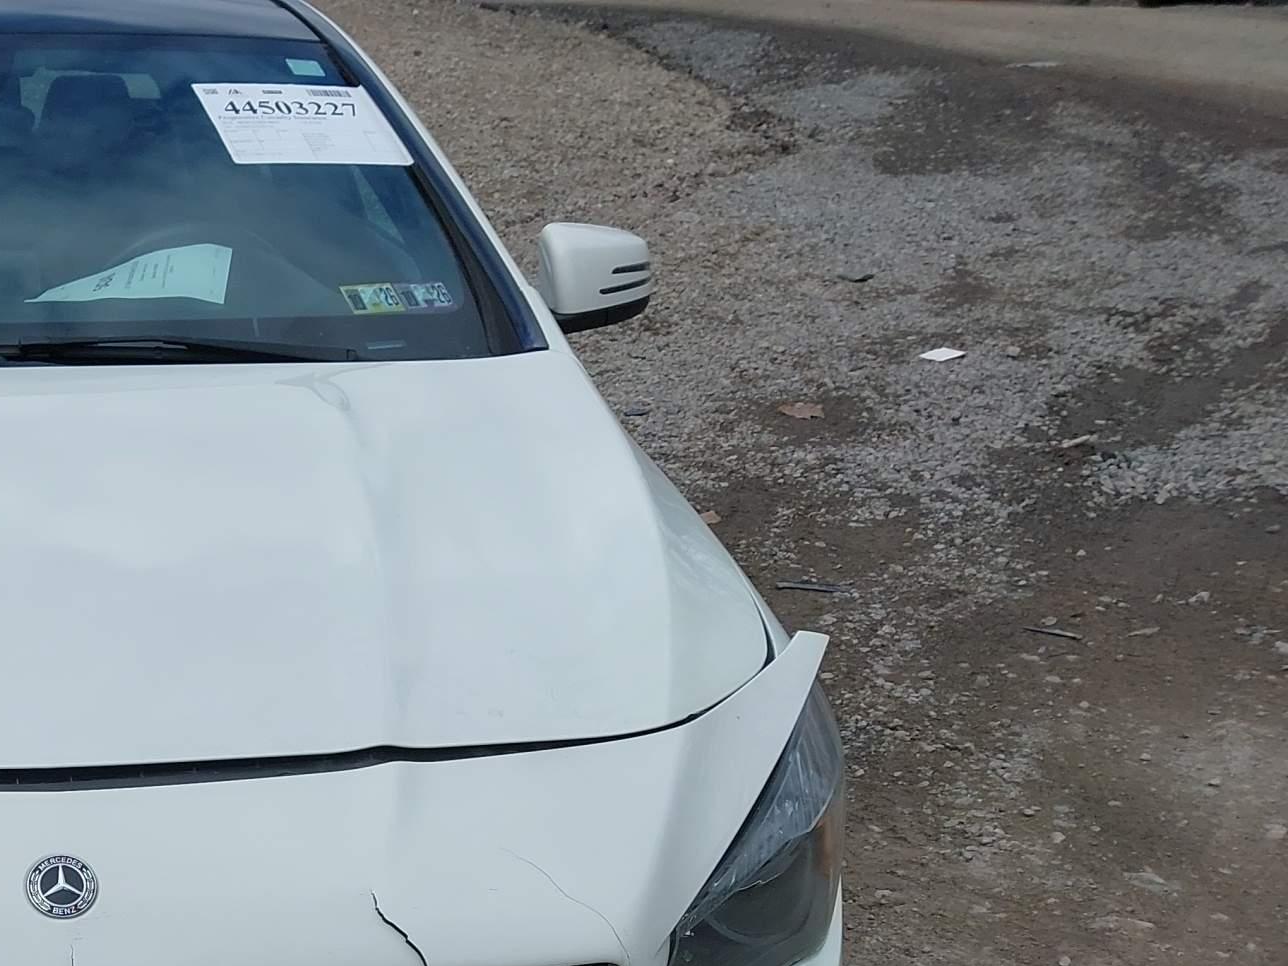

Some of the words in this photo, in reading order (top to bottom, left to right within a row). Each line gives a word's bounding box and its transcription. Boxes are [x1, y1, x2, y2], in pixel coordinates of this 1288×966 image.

[224, 100, 357, 117] 44503227
[38, 856, 83, 872] MERCEDES
[52, 906, 78, 915] BENZ
